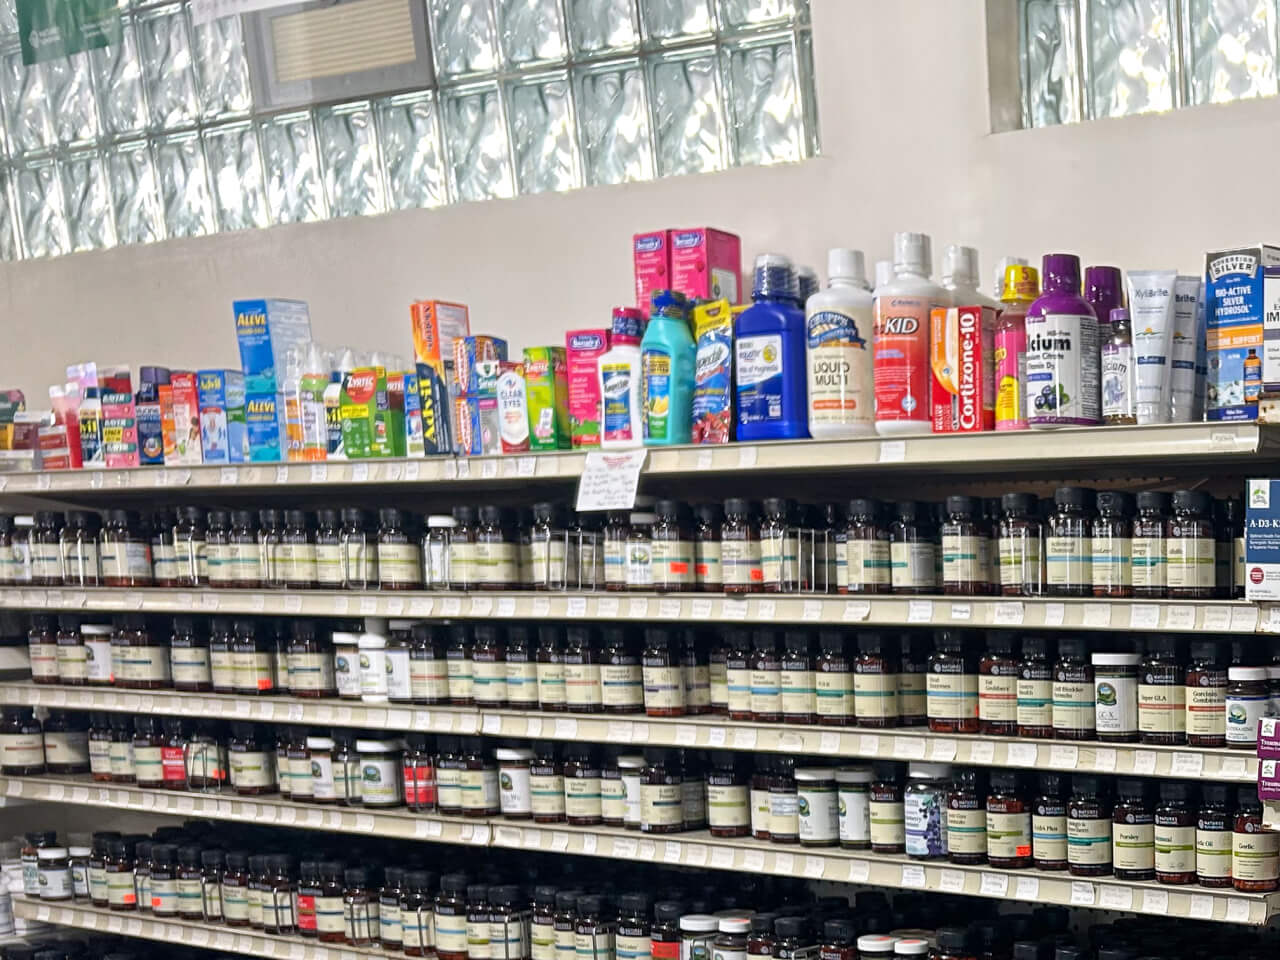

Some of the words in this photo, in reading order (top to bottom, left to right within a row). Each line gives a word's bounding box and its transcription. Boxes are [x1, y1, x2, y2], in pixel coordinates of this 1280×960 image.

[1214, 265, 1252, 274] SILVER
[885, 318, 918, 334] KID
[501, 389, 521, 399] CLEAR
[503, 400, 520, 408] EYES
